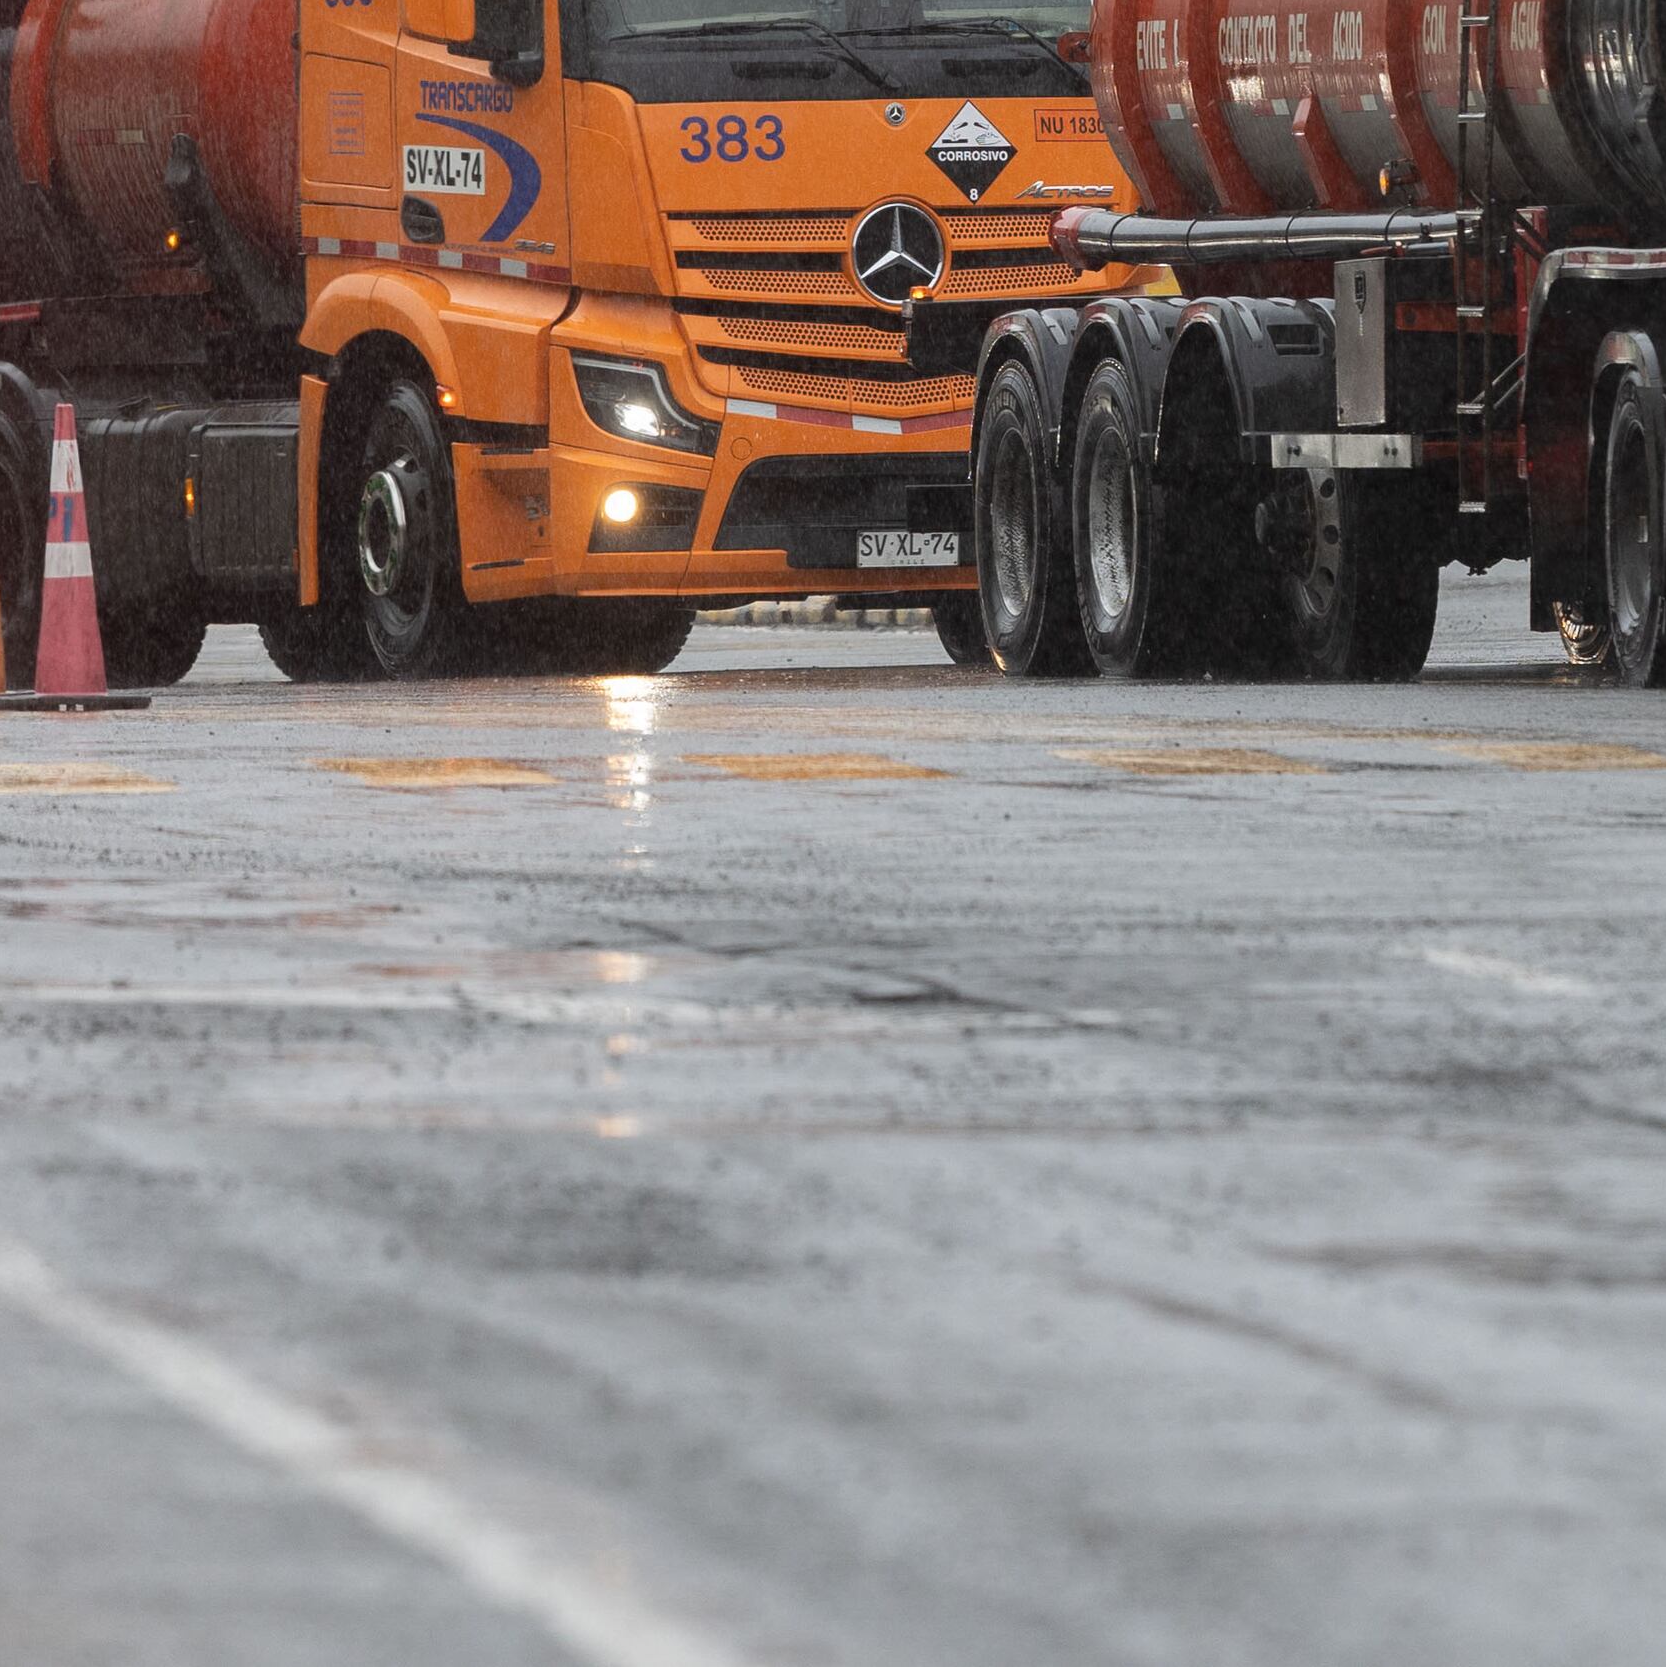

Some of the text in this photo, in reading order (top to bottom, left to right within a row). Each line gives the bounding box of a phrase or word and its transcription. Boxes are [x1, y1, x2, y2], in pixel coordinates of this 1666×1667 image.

[1136, 19, 1167, 71] EVITE
[1218, 15, 1277, 65] CONTACTO
[1288, 13, 1312, 63] DEL
[1333, 10, 1363, 61] ACIDO
[1422, 5, 1447, 54] CON
[420, 80, 513, 113] TRANSCARGO
[680, 114, 786, 164] 383
[1040, 117, 1064, 134] NU
[406, 148, 482, 189] SV-XL-74
[937, 150, 1009, 162] CORROSIVO
[969, 188, 979, 201] 8
